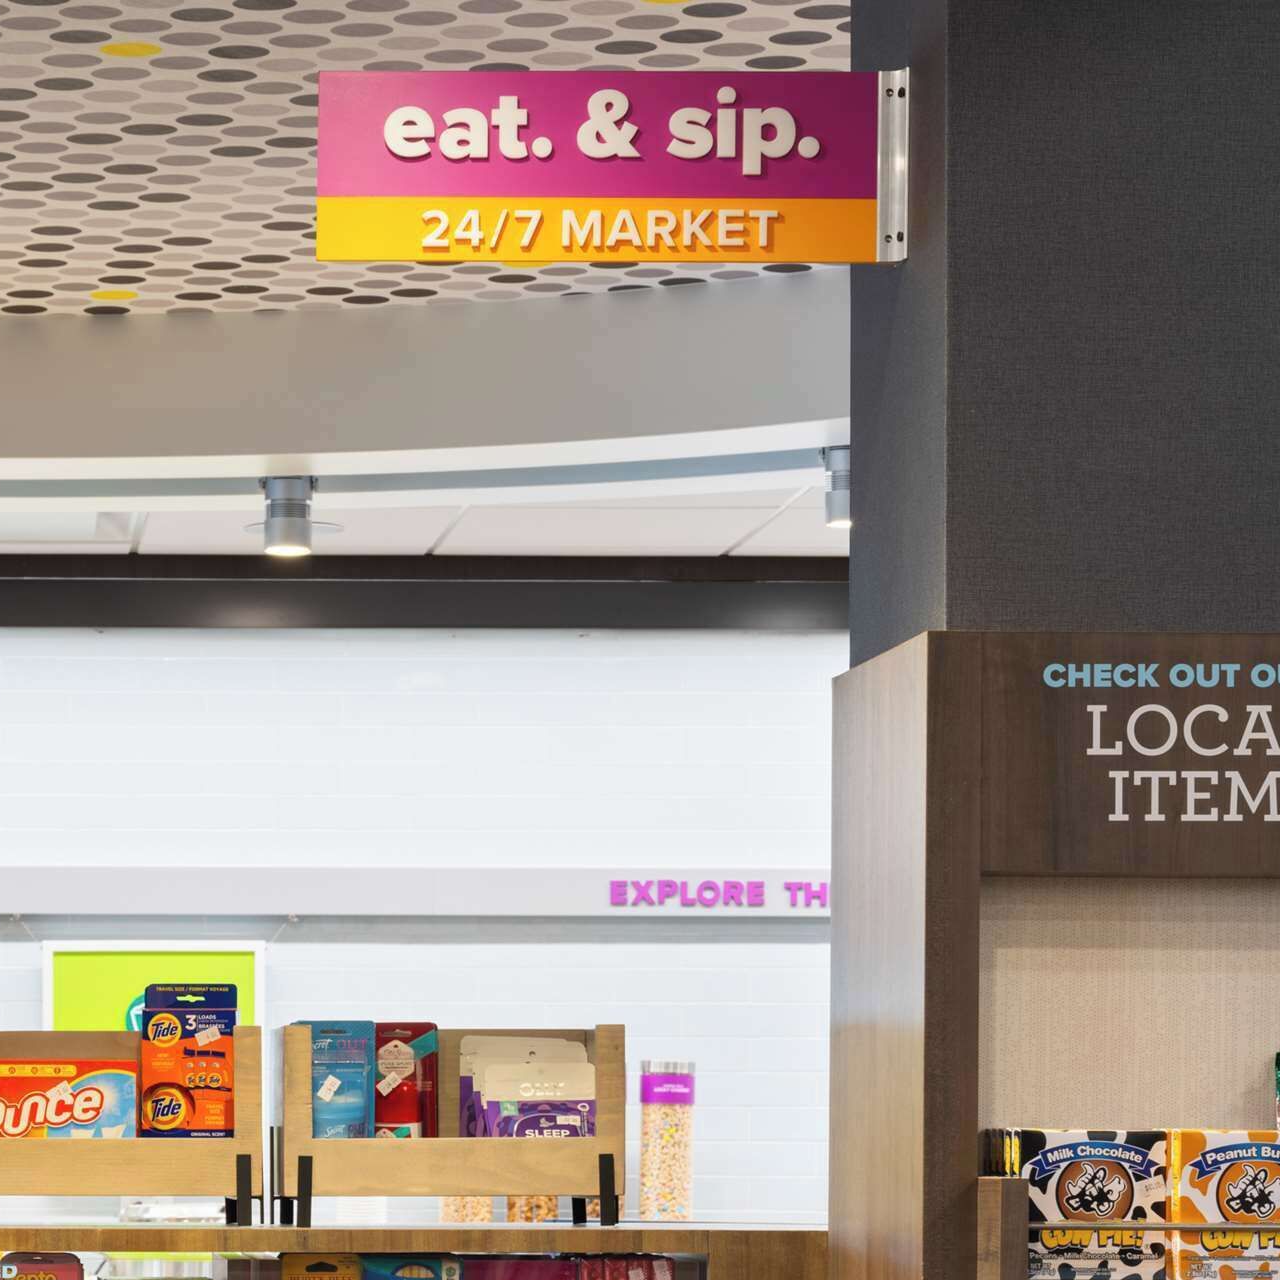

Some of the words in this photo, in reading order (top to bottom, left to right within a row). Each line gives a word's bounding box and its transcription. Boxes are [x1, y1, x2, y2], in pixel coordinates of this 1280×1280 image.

[384, 95, 553, 160] eat.
[577, 89, 641, 159] &
[667, 86, 821, 176] sip.
[421, 210, 545, 250] 24/7
[561, 210, 779, 250] MARKET
[1043, 663, 1161, 688] CHECK
[1169, 663, 1241, 688] OUT
[609, 880, 766, 907] EXPLORE
[151, 1021, 179, 1042] Tide
[184, 1014, 197, 1030] 3
[151, 1097, 182, 1122] Tide
[1046, 1145, 1075, 1164] Milk
[1076, 1144, 1145, 1166] Chocolate
[1205, 1146, 1259, 1166] Peanut
